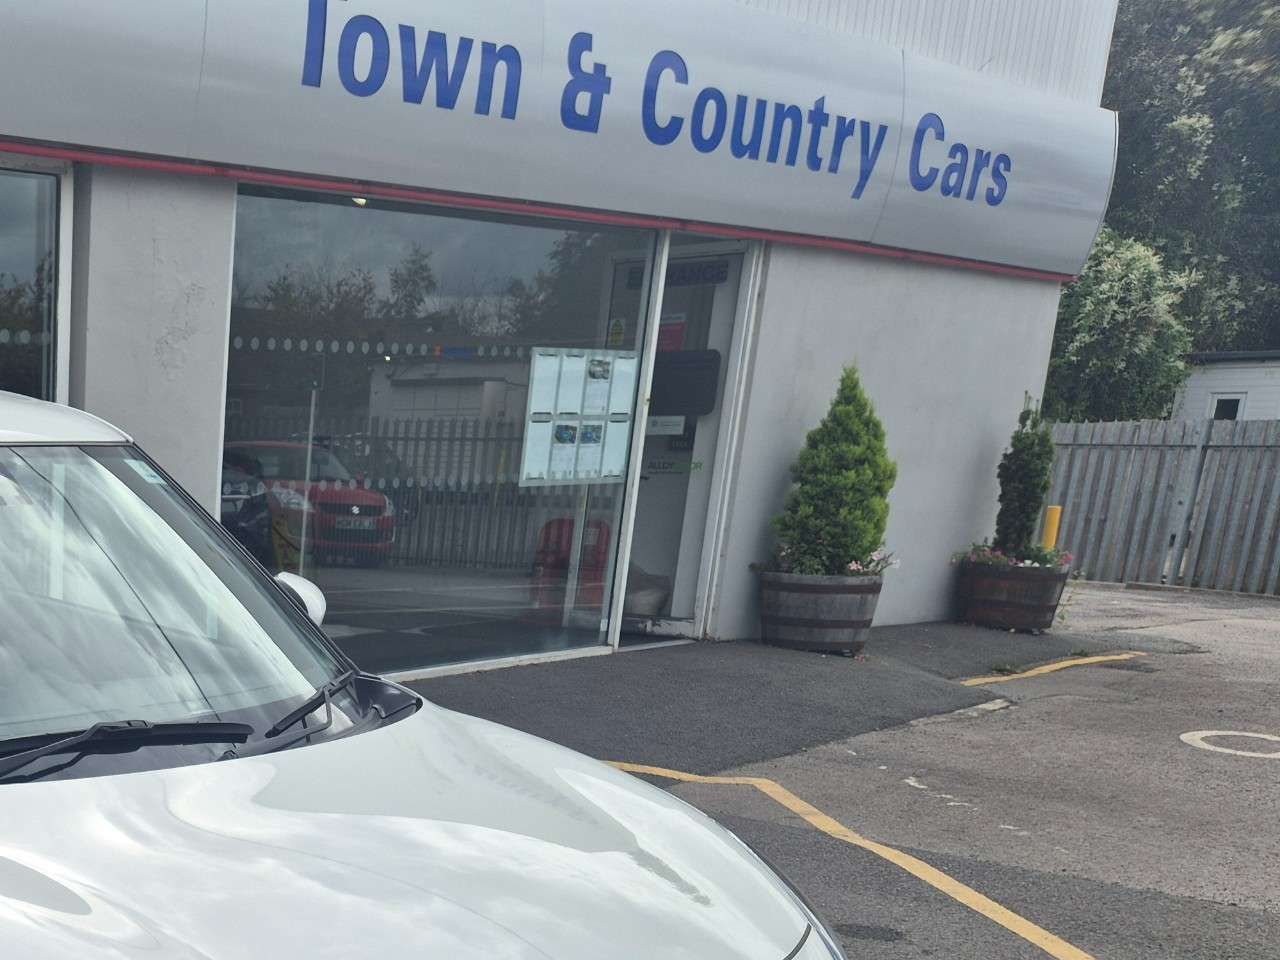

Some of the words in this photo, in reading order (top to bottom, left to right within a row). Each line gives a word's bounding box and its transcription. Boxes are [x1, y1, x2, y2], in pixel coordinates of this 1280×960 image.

[301, 0, 522, 120] Town
[560, 32, 612, 134] &
[641, 50, 888, 200] Country
[909, 113, 1011, 206] Cars
